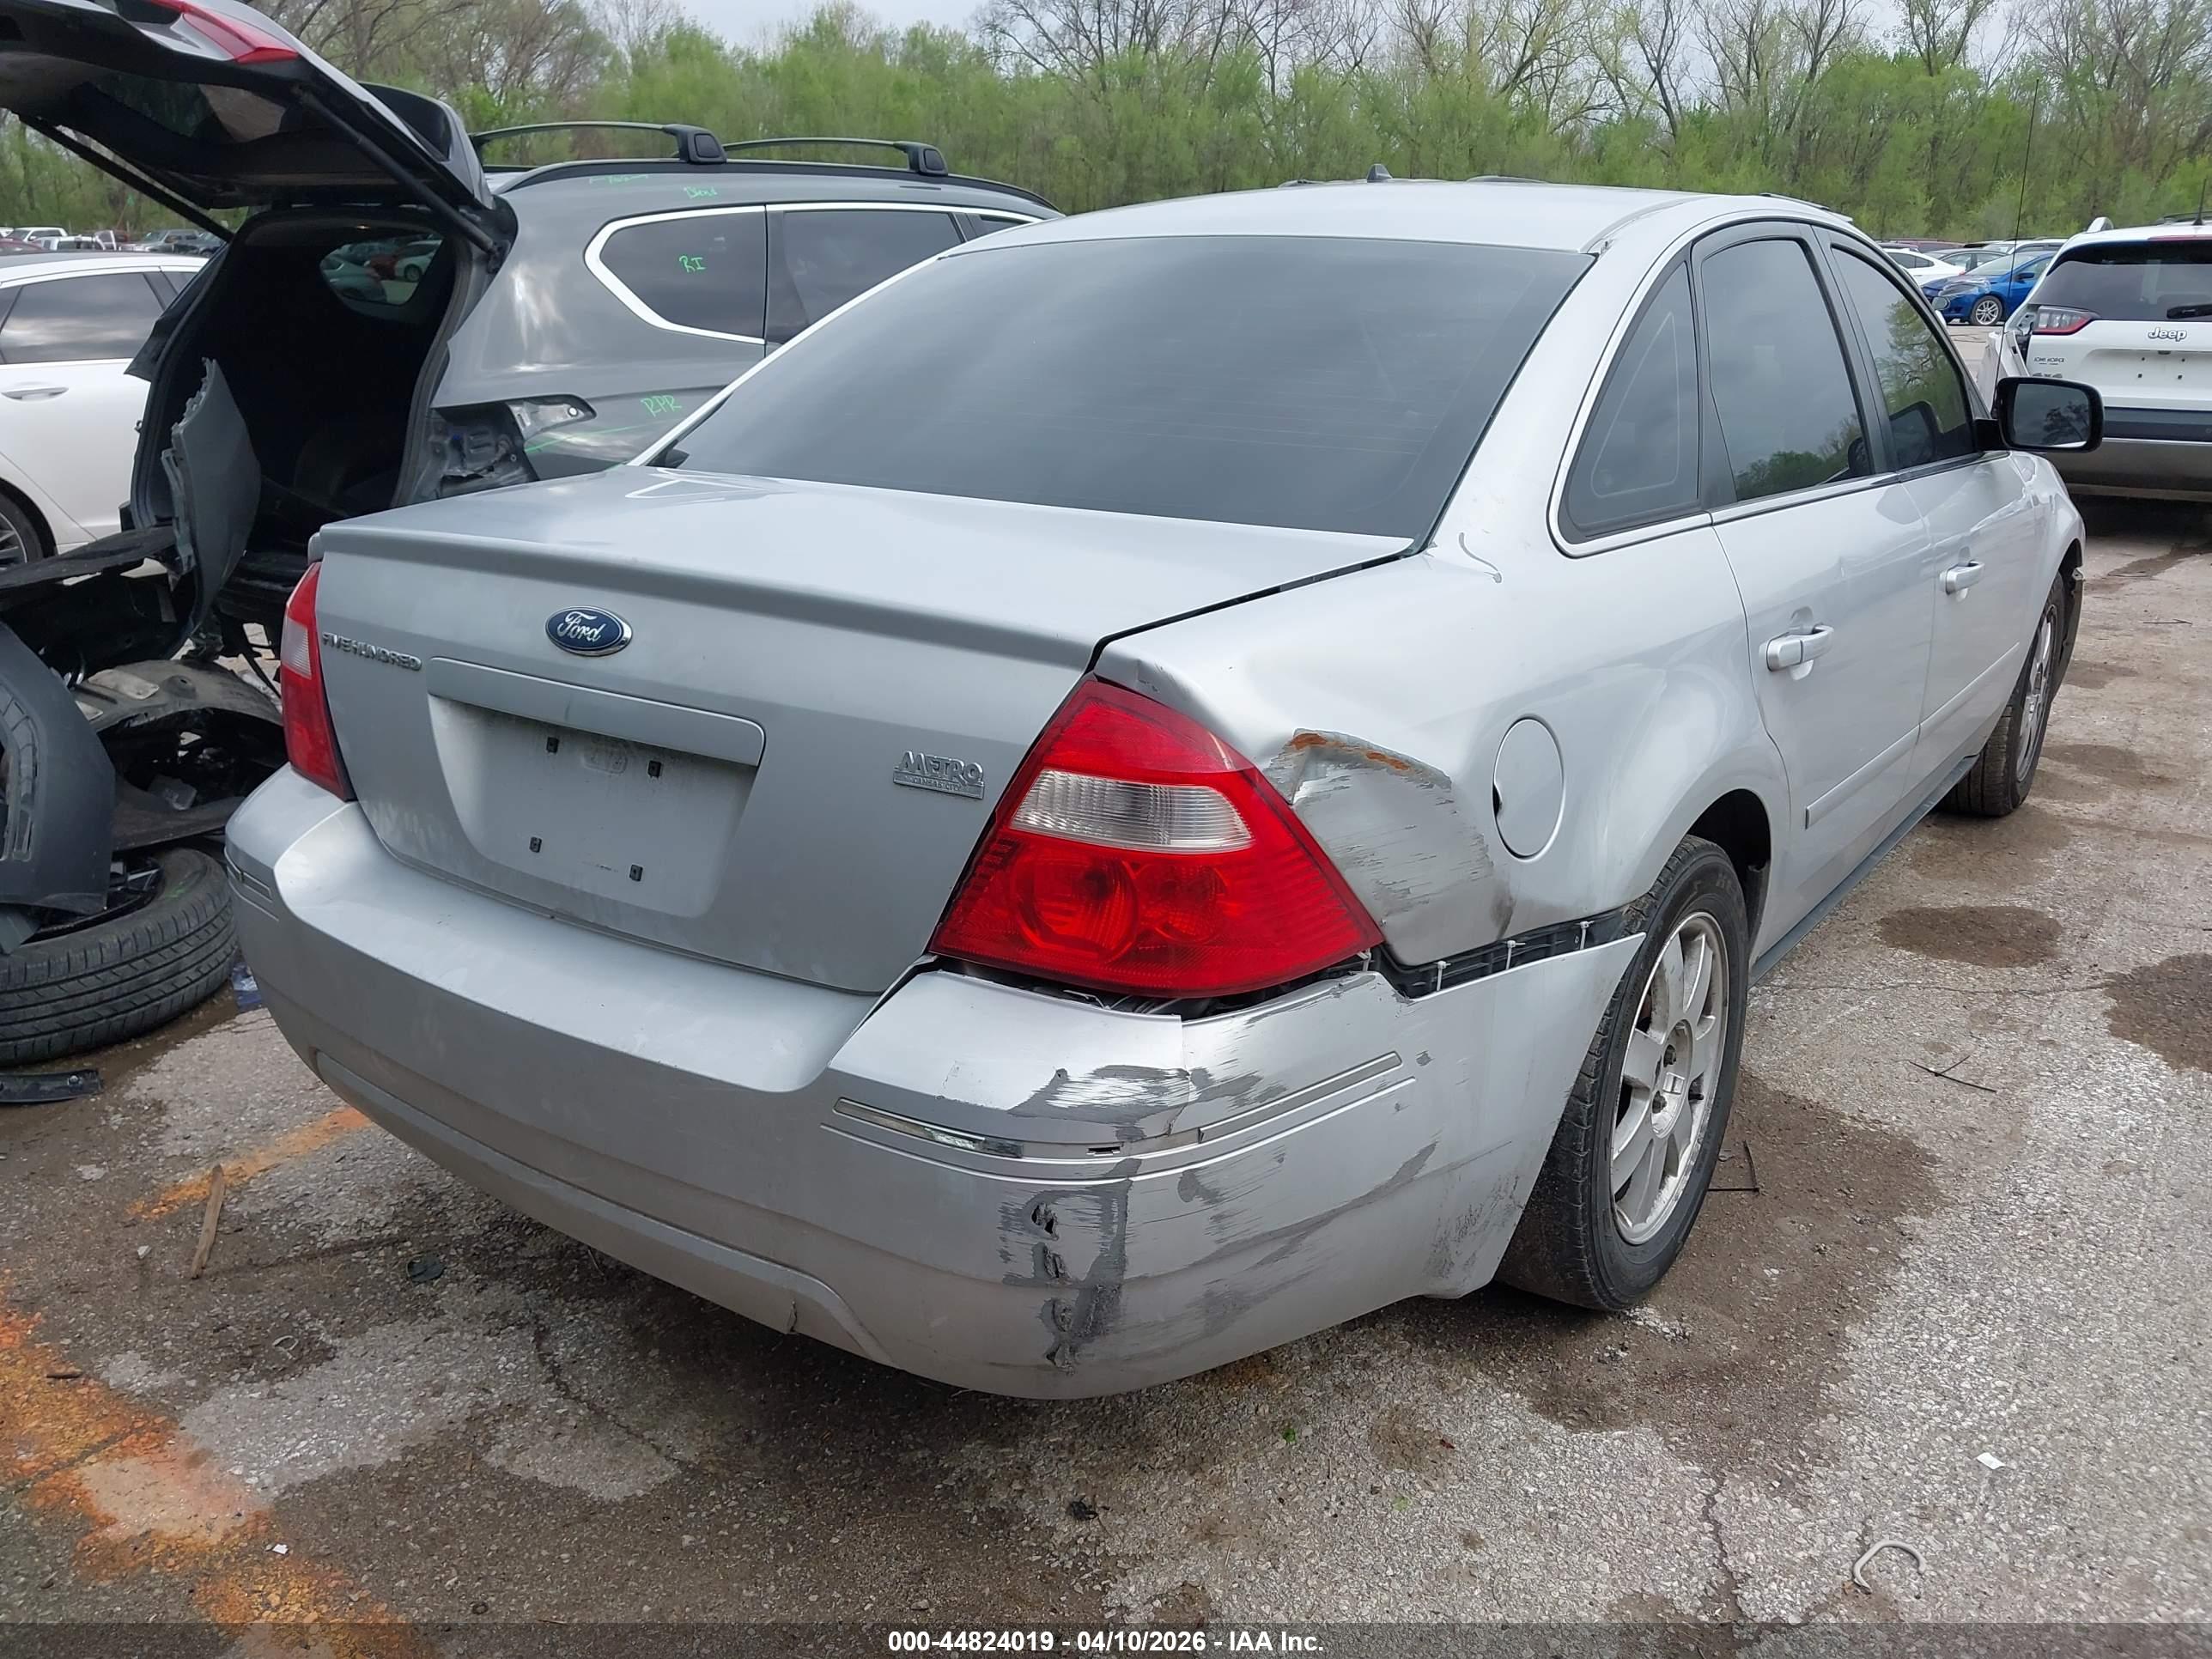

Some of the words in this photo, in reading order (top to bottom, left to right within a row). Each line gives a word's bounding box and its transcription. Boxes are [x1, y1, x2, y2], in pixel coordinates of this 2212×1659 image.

[678, 255, 705, 273] RI
[2148, 326, 2188, 342] Jeep
[640, 394, 682, 417] RPR
[556, 611, 606, 642] Ford
[895, 750, 983, 786] METRO
